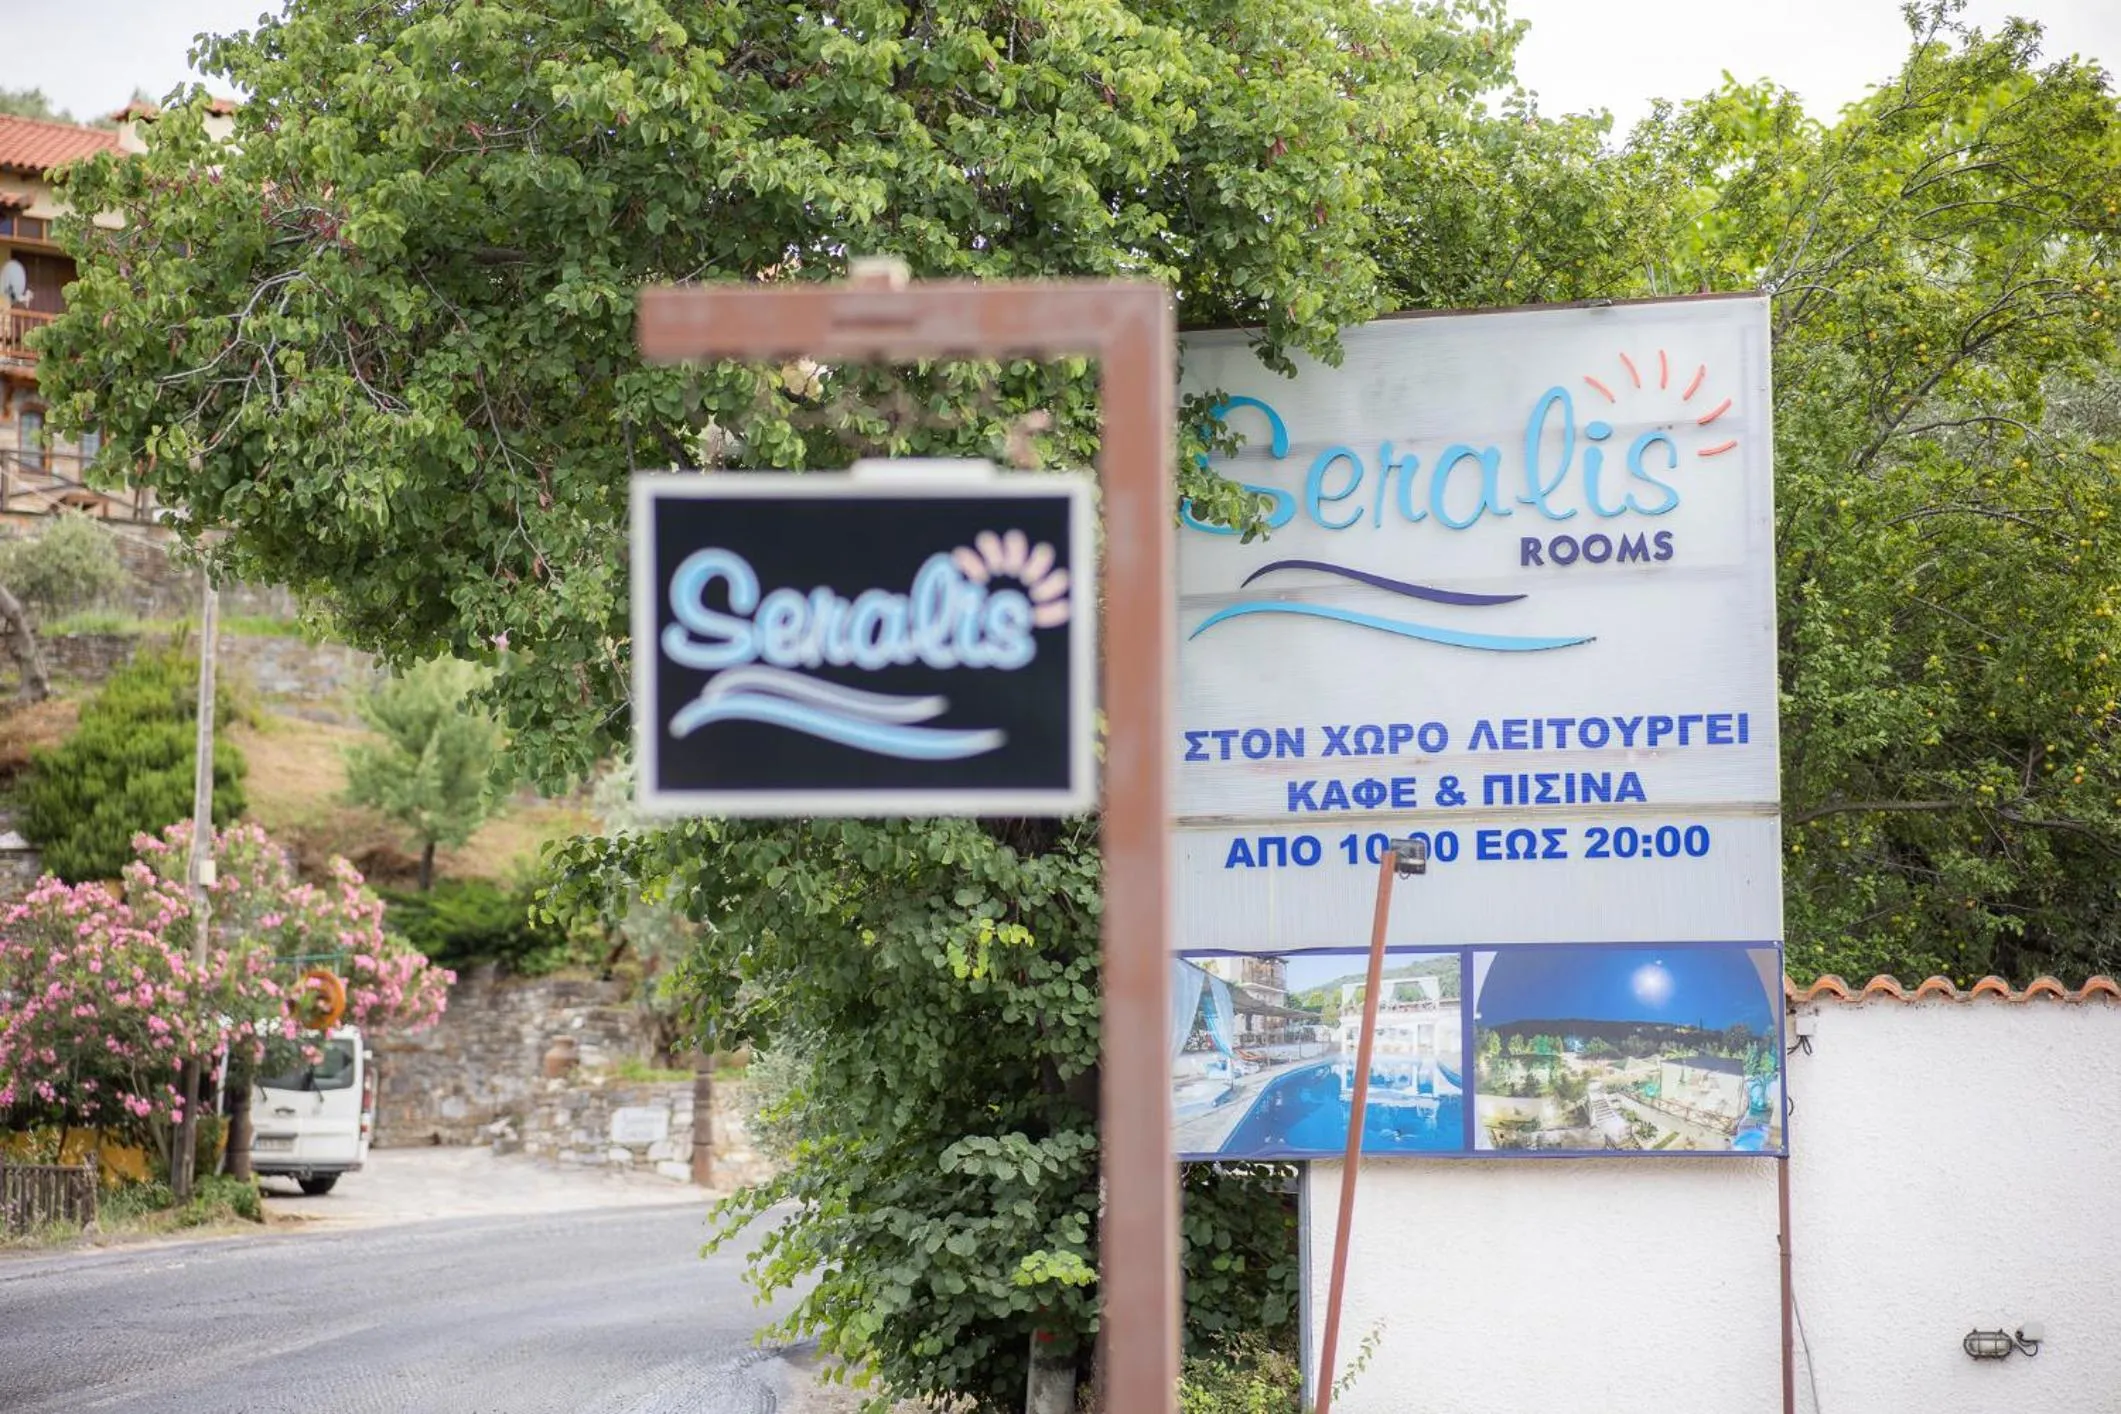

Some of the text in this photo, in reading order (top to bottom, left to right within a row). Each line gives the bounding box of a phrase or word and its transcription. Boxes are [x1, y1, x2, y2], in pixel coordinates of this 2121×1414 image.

[1179, 386, 1680, 535] Seralis
[1520, 530, 1674, 566] ROOMS
[661, 546, 1037, 671] Seralis
[1183, 712, 1750, 762] ΣΤΟΝ ΧΩΡΟ ΛΕΙΤΟΥΡΓΕΙ
[1286, 771, 1647, 812] ΚΑΦΕ & ΠΙΣΙΝΑ
[1224, 824, 1711, 869] ΑΠΟ 100 ΕΩΣ 20:00
